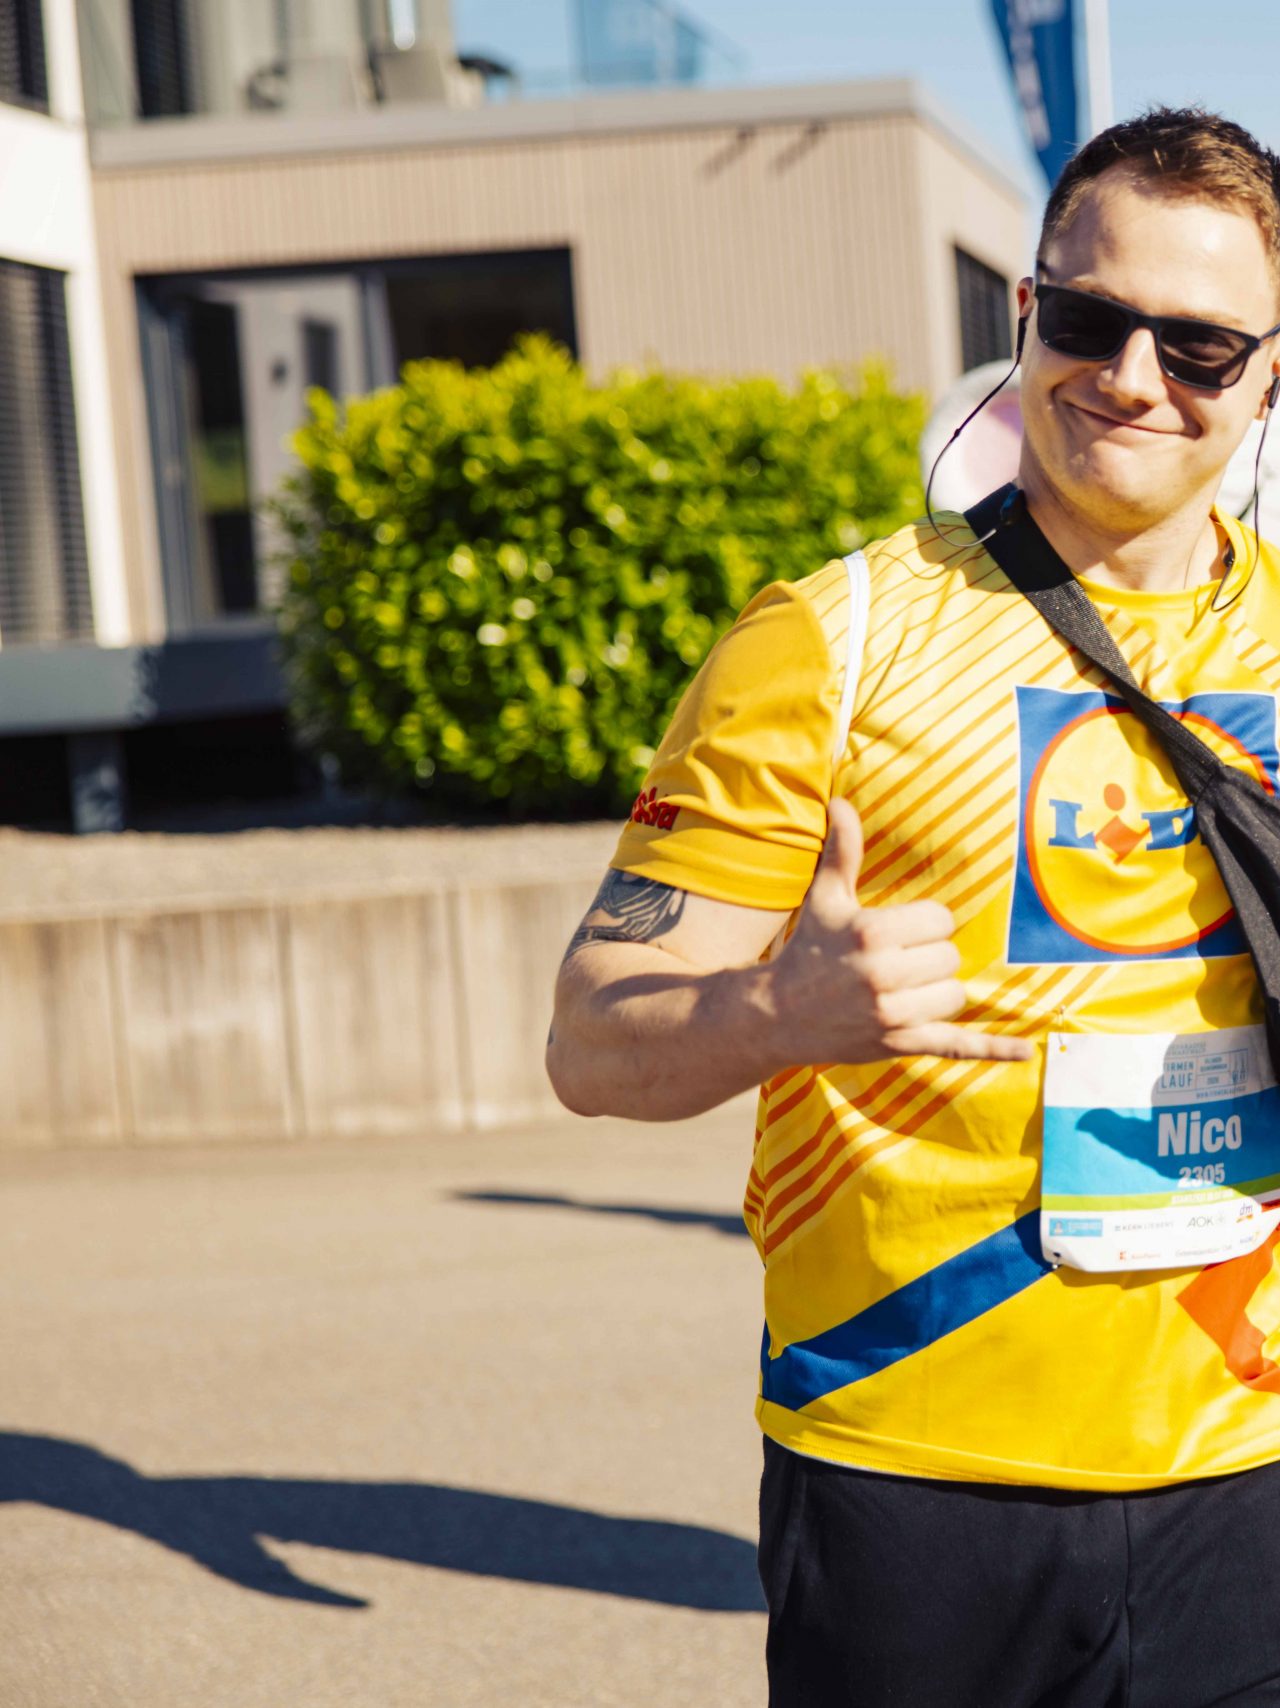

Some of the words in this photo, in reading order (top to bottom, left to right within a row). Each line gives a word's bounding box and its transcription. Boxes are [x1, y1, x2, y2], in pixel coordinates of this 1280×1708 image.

[1160, 1072, 1193, 1089] LAUF
[1157, 1110, 1242, 1157] Nico
[1178, 1162, 1225, 1188] 2305
[1187, 1215, 1214, 1228] AOK
